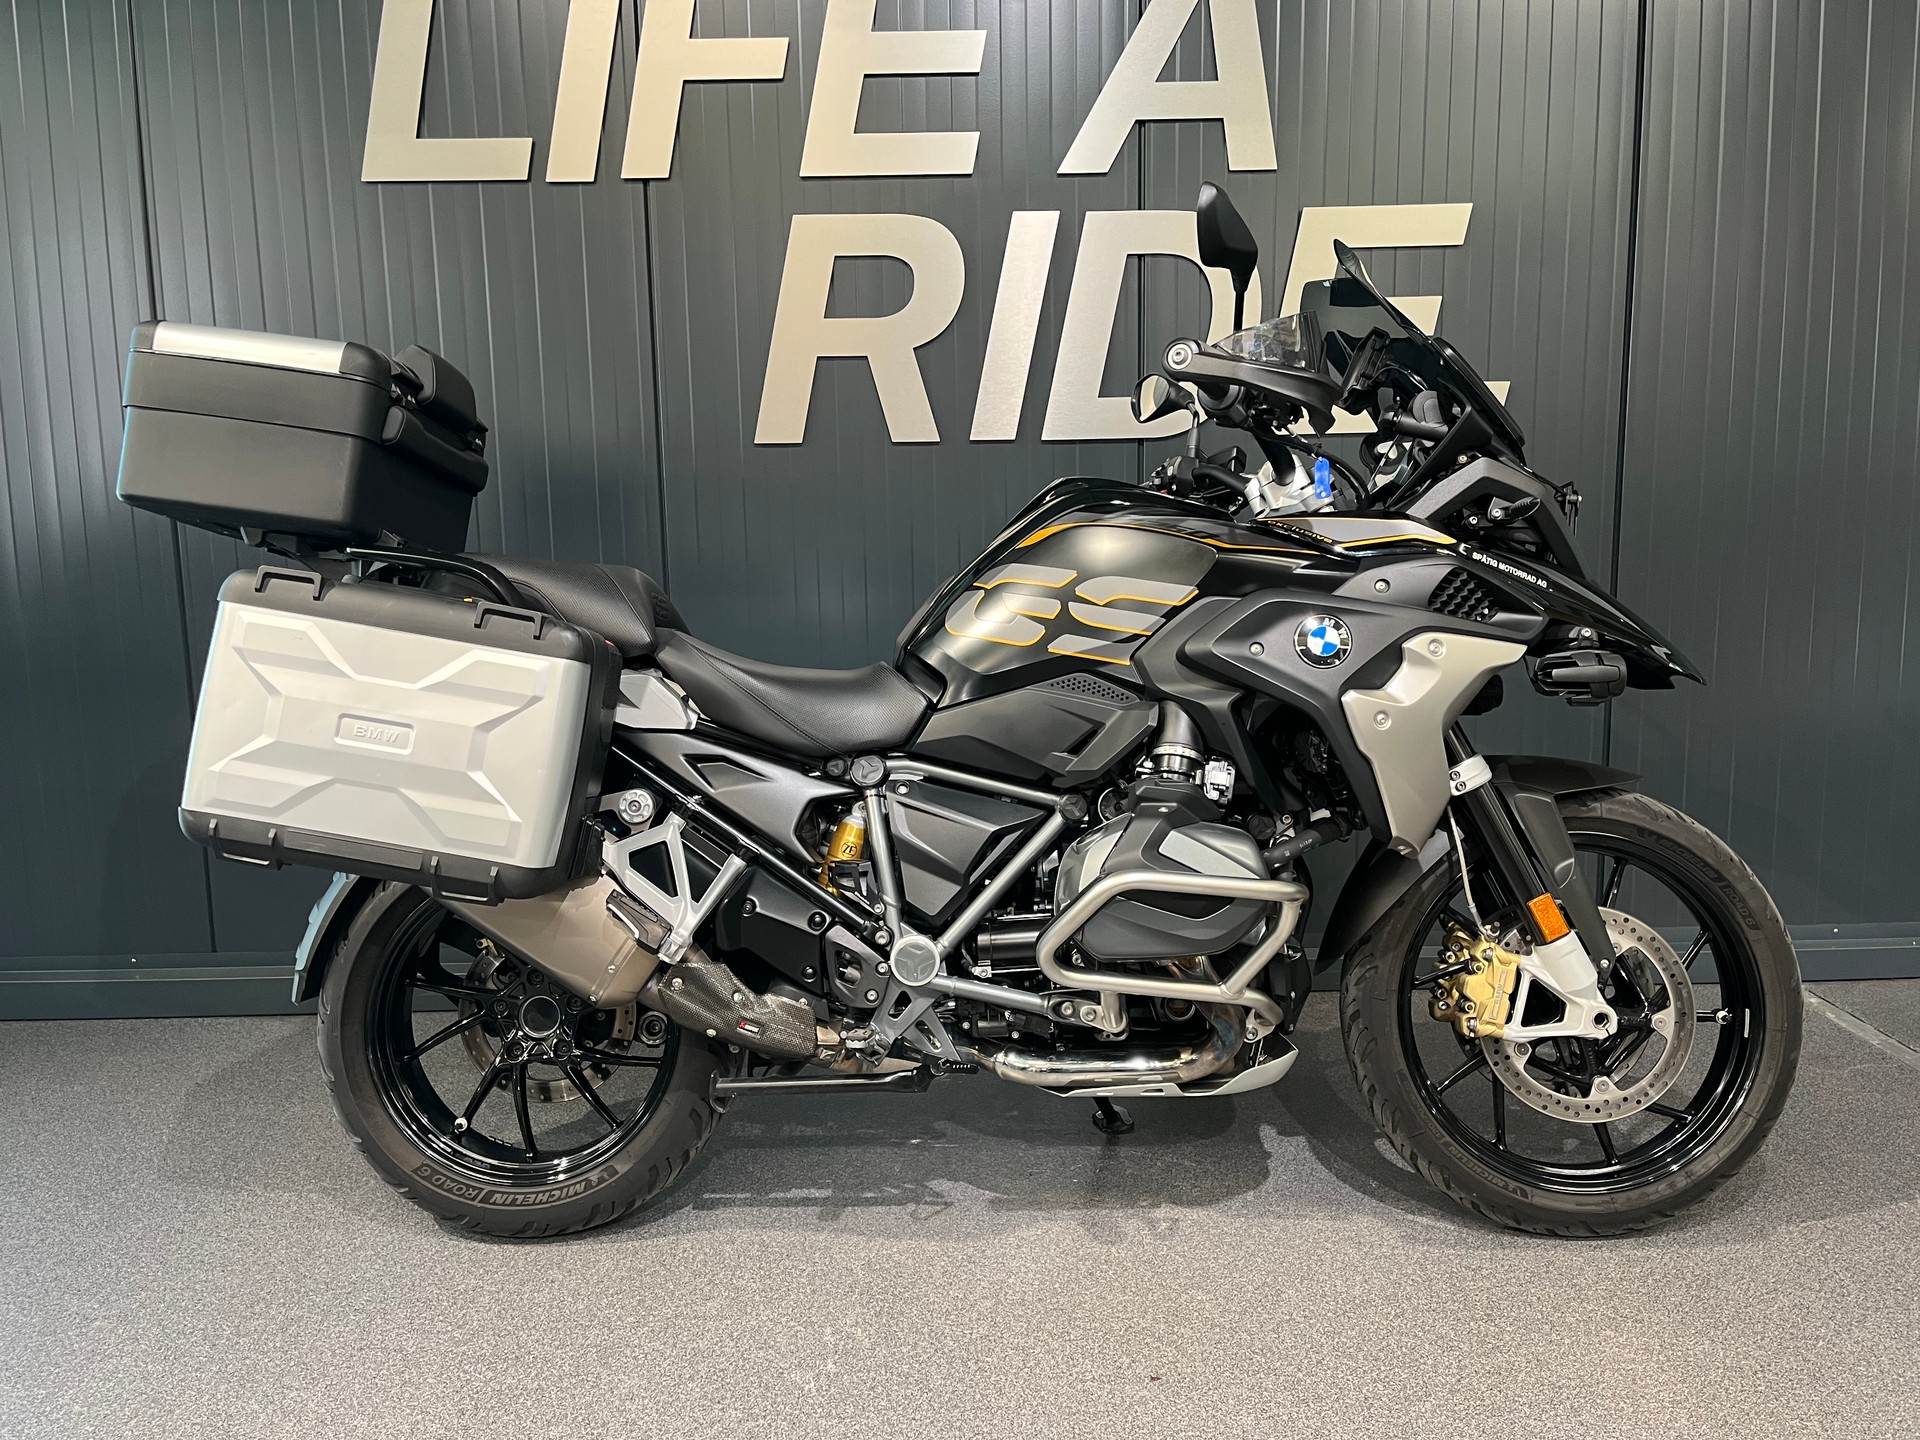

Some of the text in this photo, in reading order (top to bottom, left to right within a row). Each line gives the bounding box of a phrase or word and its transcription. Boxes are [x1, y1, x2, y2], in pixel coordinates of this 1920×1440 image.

[361, 0, 1278, 183] LIFE A
[754, 202, 1511, 444] RIDE
[1267, 520, 1333, 544] exclusive
[1498, 561, 1537, 584] MOTORRAD
[1536, 578, 1548, 589] AG
[945, 563, 1198, 666] GS
[353, 724, 400, 743] BMW
[843, 844, 857, 854] ZF
[1657, 839, 1719, 880] MICHELIN
[1722, 887, 1750, 916] ROAD
[416, 1166, 586, 1206] MICHELIN ROAD 6
[1448, 1144, 1508, 1191] MICHELIN
